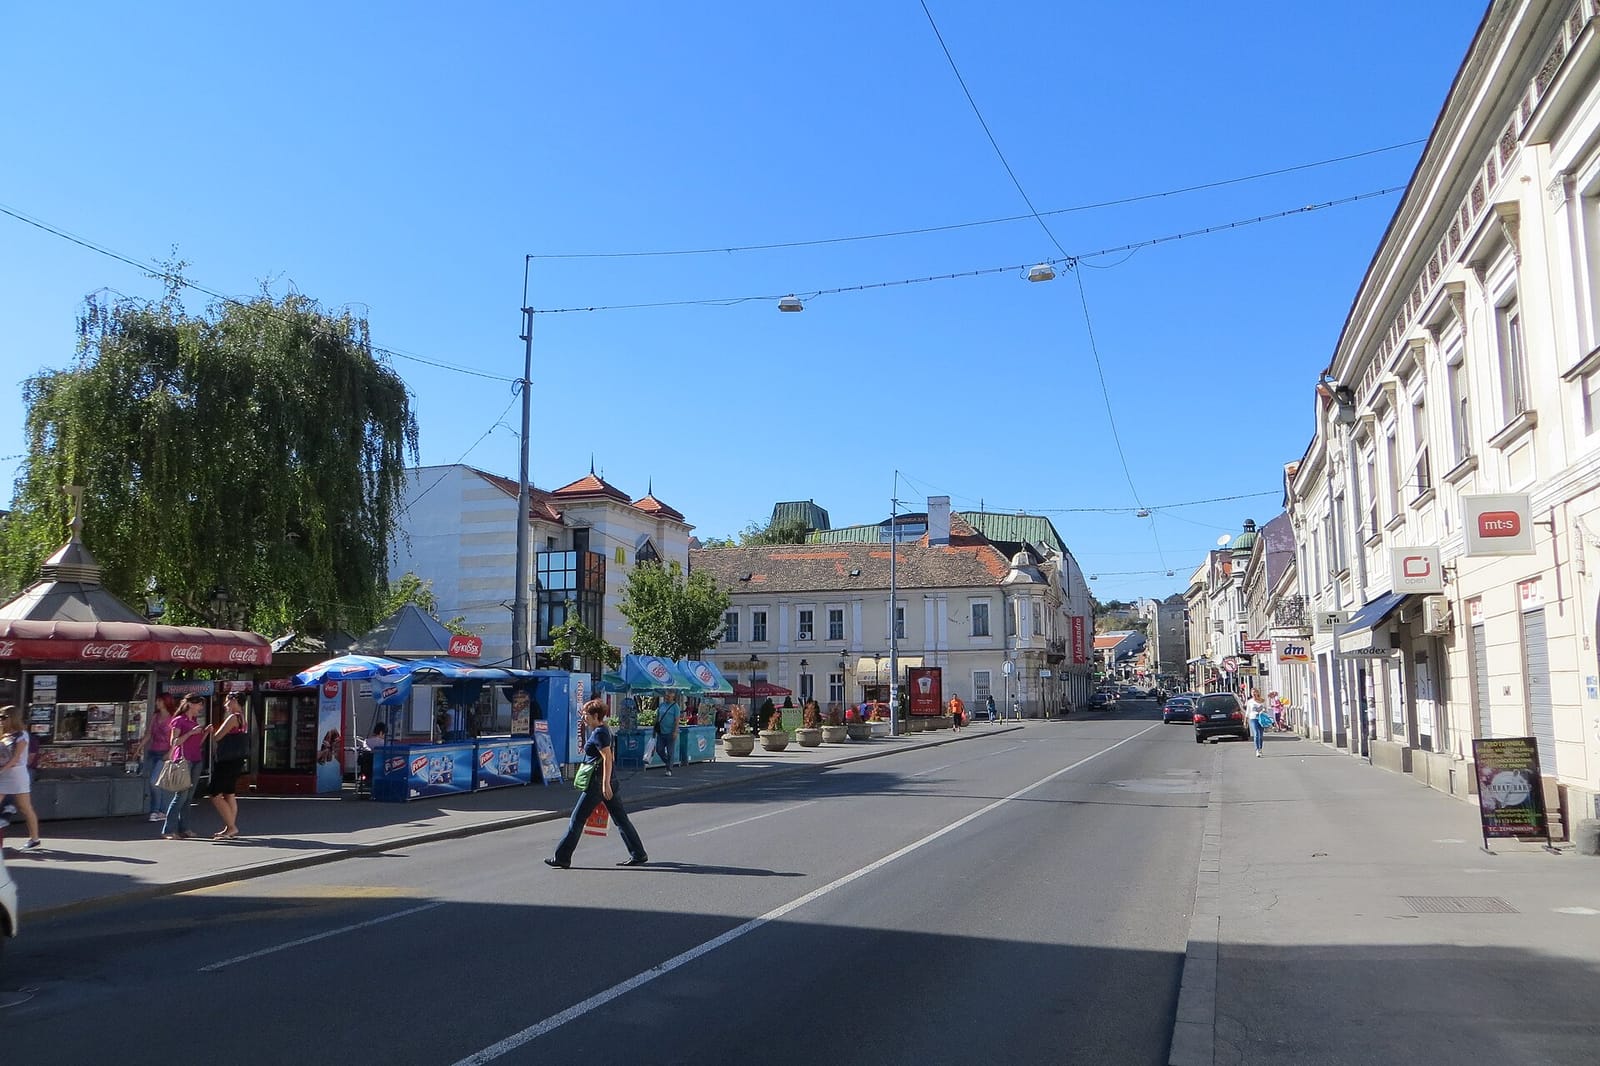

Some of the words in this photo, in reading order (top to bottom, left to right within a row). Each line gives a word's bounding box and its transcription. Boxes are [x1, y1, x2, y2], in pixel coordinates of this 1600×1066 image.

[1485, 519, 1514, 530] mt:s
[82, 642, 133, 659] Coca-Cola
[171, 645, 202, 660] Coca-Cola
[229, 648, 257, 662] Coca-Cola
[1284, 643, 1305, 655] dm
